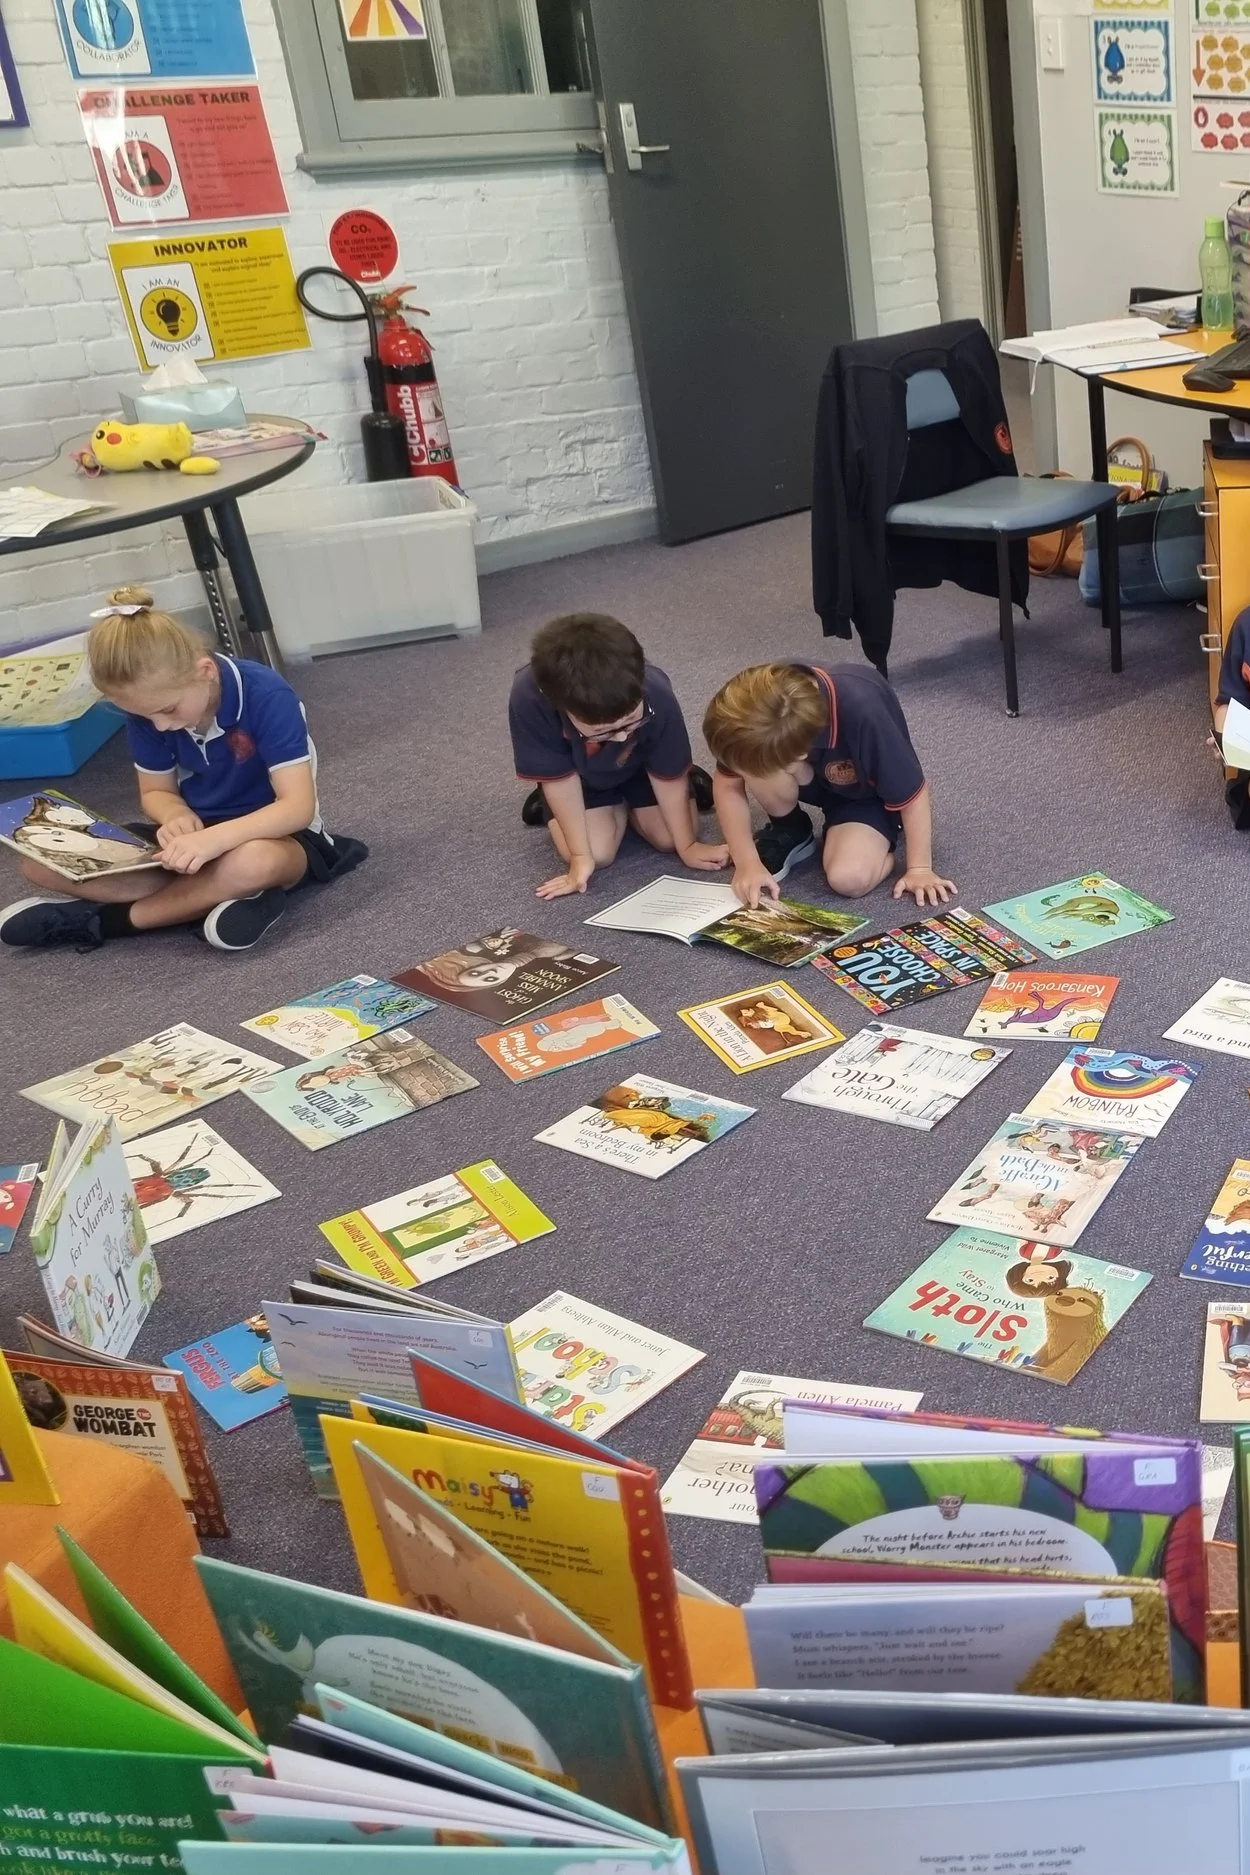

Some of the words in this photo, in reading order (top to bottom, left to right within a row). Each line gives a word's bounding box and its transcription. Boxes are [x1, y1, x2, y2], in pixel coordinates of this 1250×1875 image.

[199, 90, 251, 105] TAKER
[153, 236, 249, 258] INNOVATOR
[148, 278, 164, 288] AM
[166, 278, 181, 288] AN
[150, 334, 203, 353] INNOVATOR
[397, 384, 421, 448] Chubb
[914, 930, 962, 960] SPACE
[876, 940, 941, 983] CHOOSE
[956, 956, 979, 971] IN
[836, 951, 915, 1000] YOU
[1030, 981, 1106, 997] Kangaroos
[1181, 1027, 1212, 1042] Bird
[1215, 1036, 1225, 1044] a
[831, 1067, 896, 1092] Gate
[830, 1085, 913, 1111] Through
[897, 1083, 919, 1097] the
[340, 1092, 373, 1114] LANE
[1061, 1095, 1139, 1118] RAINBOW
[574, 1137, 594, 1150] Sea
[578, 1128, 626, 1150] Bedroom
[627, 1140, 646, 1154] my
[603, 1145, 641, 1165] There's
[68, 1213, 78, 1236] A
[75, 1177, 104, 1219] Curry
[69, 1237, 87, 1269] for
[82, 1191, 116, 1240] Murray
[956, 1241, 975, 1253] Wild
[977, 1245, 1009, 1260] Margaret
[372, 1258, 395, 1280] GREEN
[958, 1269, 987, 1289] Stay
[954, 1280, 991, 1305] Came
[908, 1279, 1028, 1342] Sloth
[994, 1297, 1026, 1312] Who
[561, 1305, 596, 1327] Ahlberg
[595, 1320, 623, 1338] Allan
[621, 1333, 642, 1346] and
[642, 1339, 669, 1358] Janet
[977, 1341, 994, 1350] The
[181, 1348, 226, 1390] FERGUS
[512, 1327, 641, 1395] School
[795, 1390, 839, 1407] Allen
[842, 1395, 903, 1412] Pamela
[73, 1404, 137, 1421] GEORGE
[73, 1417, 156, 1438] WOMBAT
[515, 1512, 531, 1522] Fun
[842, 1545, 874, 1555] school,
[877, 1543, 906, 1555] Worry
[909, 1541, 951, 1551] Monster
[954, 1541, 995, 1551] appears
[998, 1540, 1007, 1548] in
[1008, 1538, 1023, 1548] his
[1024, 1537, 1069, 1547] bedroom.
[862, 1534, 880, 1542] The
[882, 1533, 908, 1545] night
[911, 1532, 944, 1542] before
[948, 1530, 975, 1540] Archie
[980, 1529, 1010, 1538] starts
[1012, 1528, 1027, 1537] his
[1029, 1528, 1048, 1536] new
[978, 1556, 1000, 1565] that
[1003, 1555, 1018, 1564] his
[1019, 1554, 1042, 1564] head
[1044, 1554, 1072, 1563] hurts,
[2, 1805, 49, 1820] what
[52, 1811, 63, 1821] a
[67, 1810, 113, 1826] grub
[114, 1813, 154, 1828] you
[17, 1844, 51, 1860] and
[55, 1846, 107, 1864] brush
[110, 1852, 154, 1869] your
[1060, 1845, 1087, 1855] high
